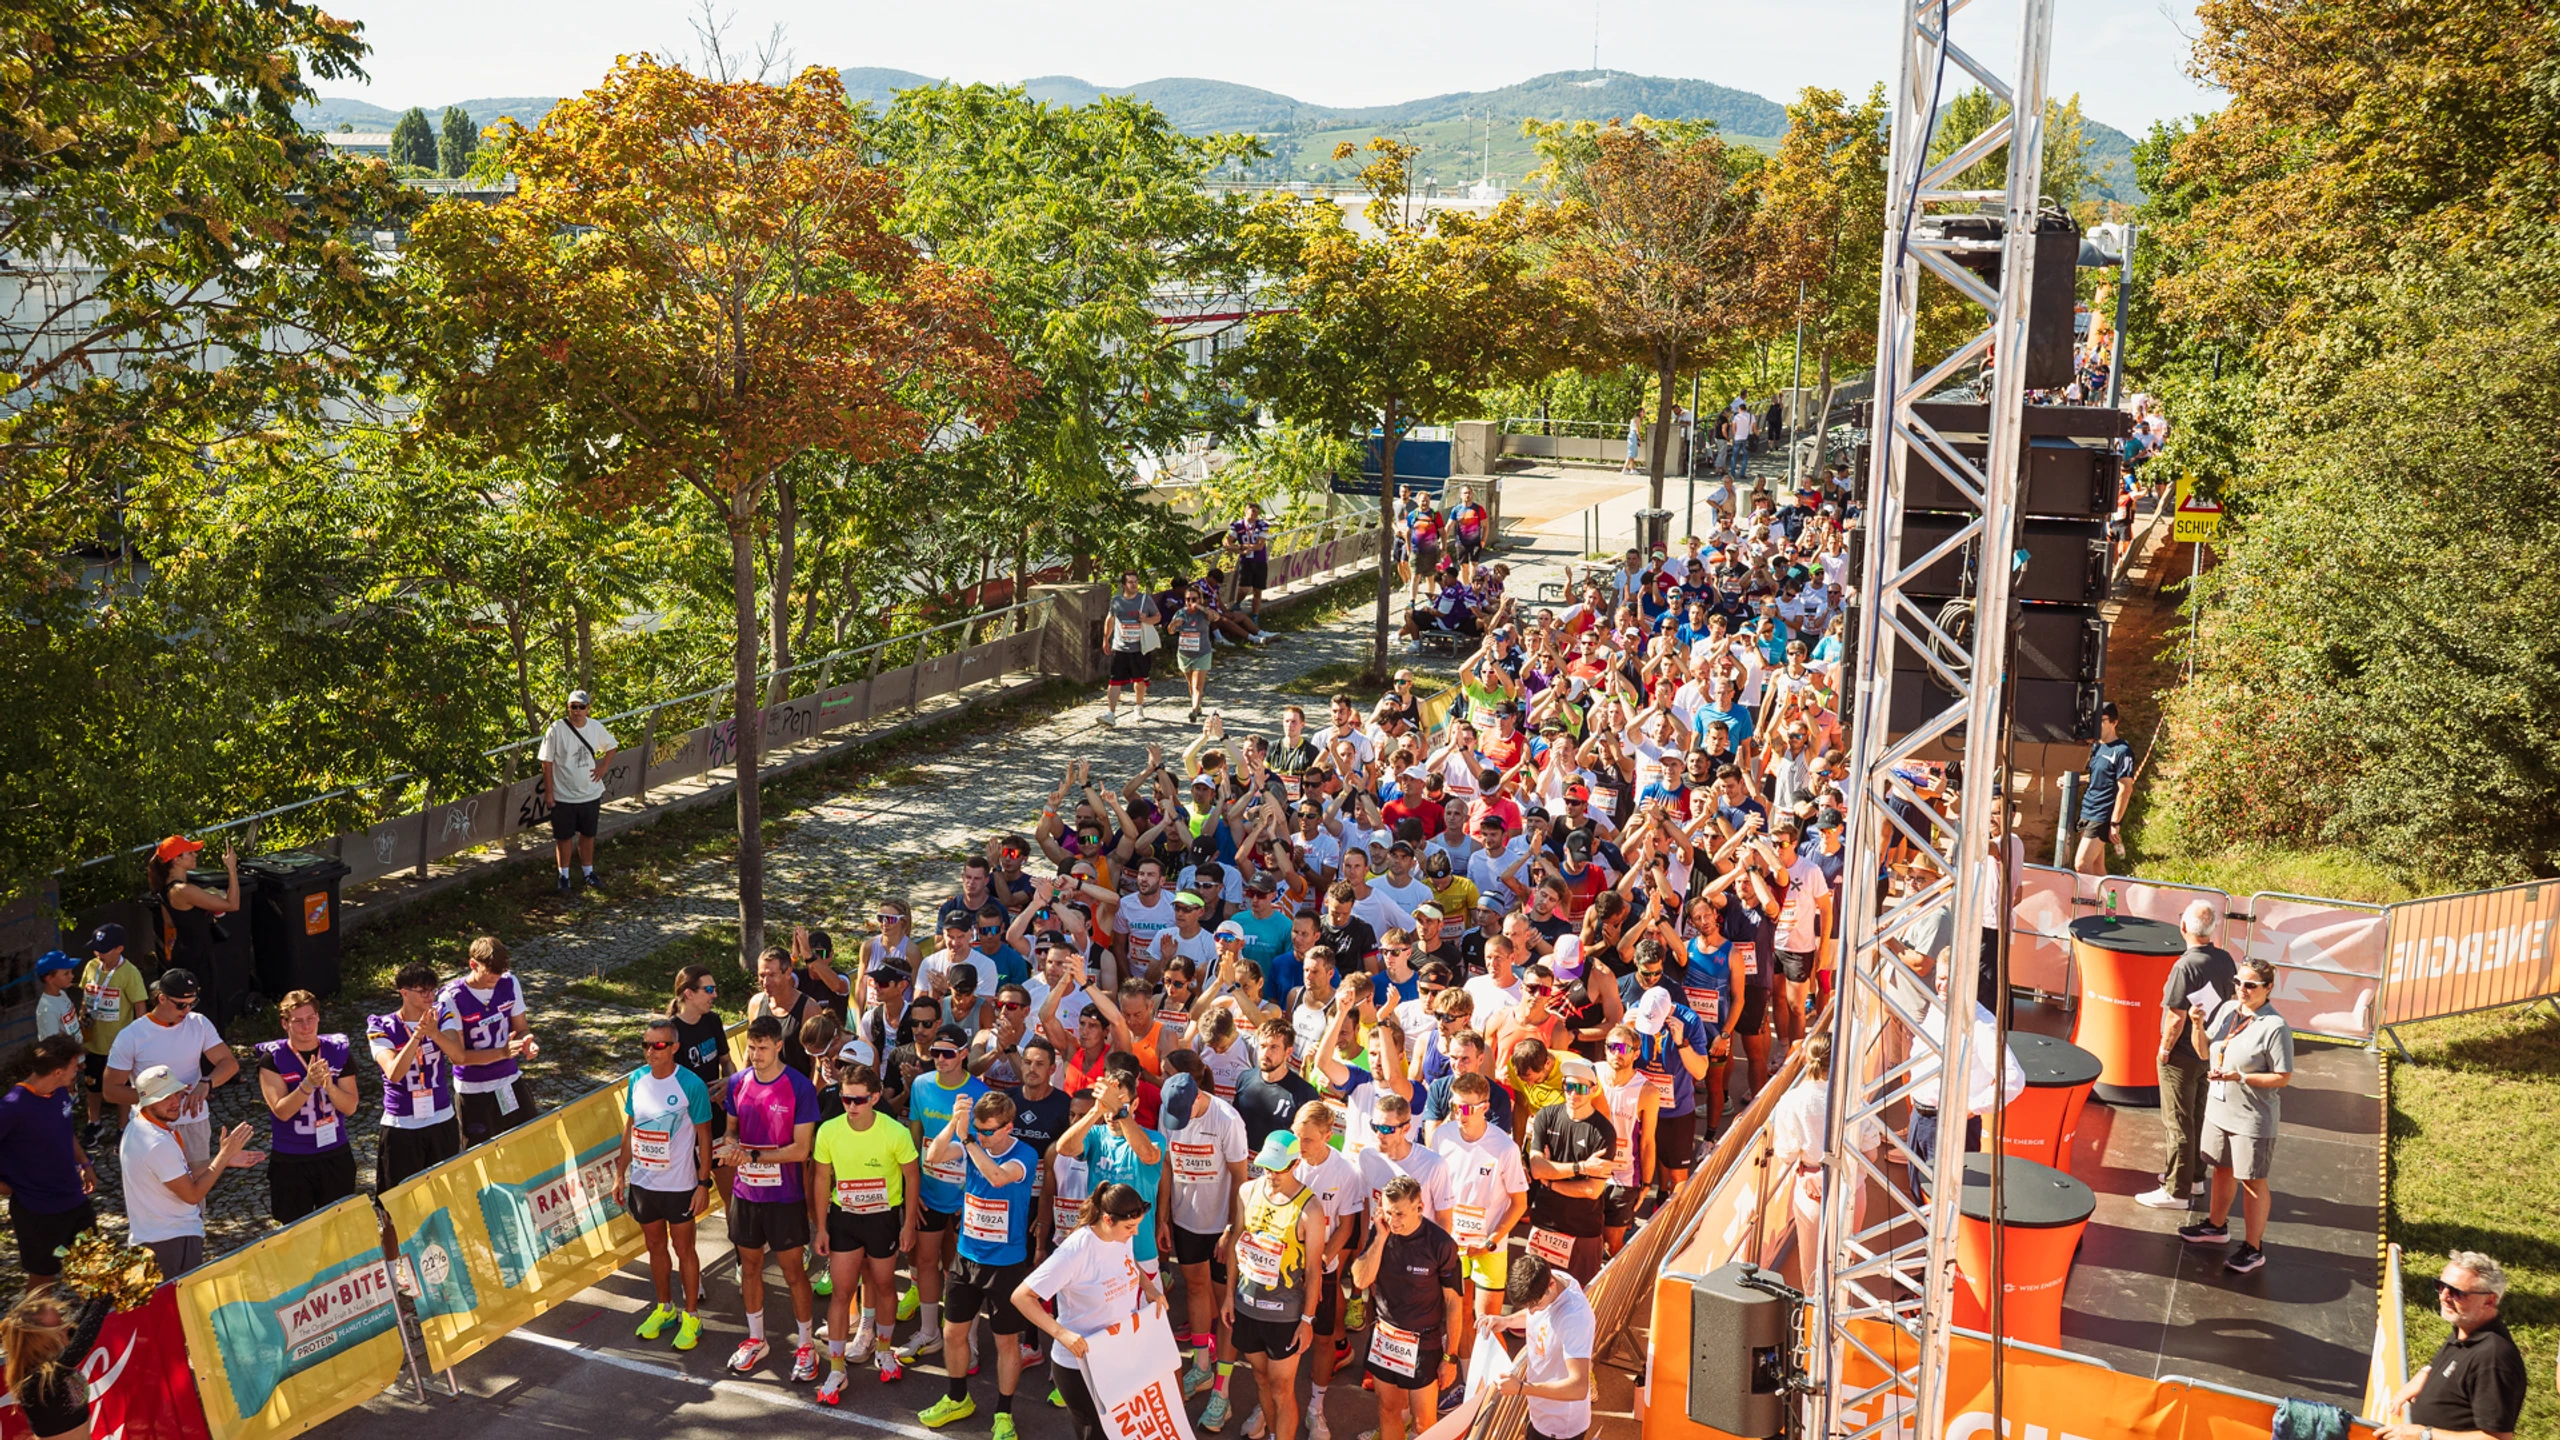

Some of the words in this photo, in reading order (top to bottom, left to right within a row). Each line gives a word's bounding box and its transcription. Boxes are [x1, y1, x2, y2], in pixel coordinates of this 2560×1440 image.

[2177, 520, 2214, 534] SCHU
[1129, 921, 1167, 931] SIEMENS
[2114, 998, 2141, 1007] ENERGIE
[2013, 1138, 2045, 1146] ENERGIE
[1479, 1167, 1492, 1176] EY
[1322, 1193, 1335, 1201] EY
[976, 1213, 1004, 1225] 7692A
[553, 1214, 583, 1236] PROTEN
[422, 1253, 447, 1272] 22%
[2019, 1284, 2039, 1292] WIEN
[297, 1333, 335, 1357] PROTEIN
[338, 1321, 362, 1338] PEANUT
[362, 1308, 391, 1326] CARAMEL
